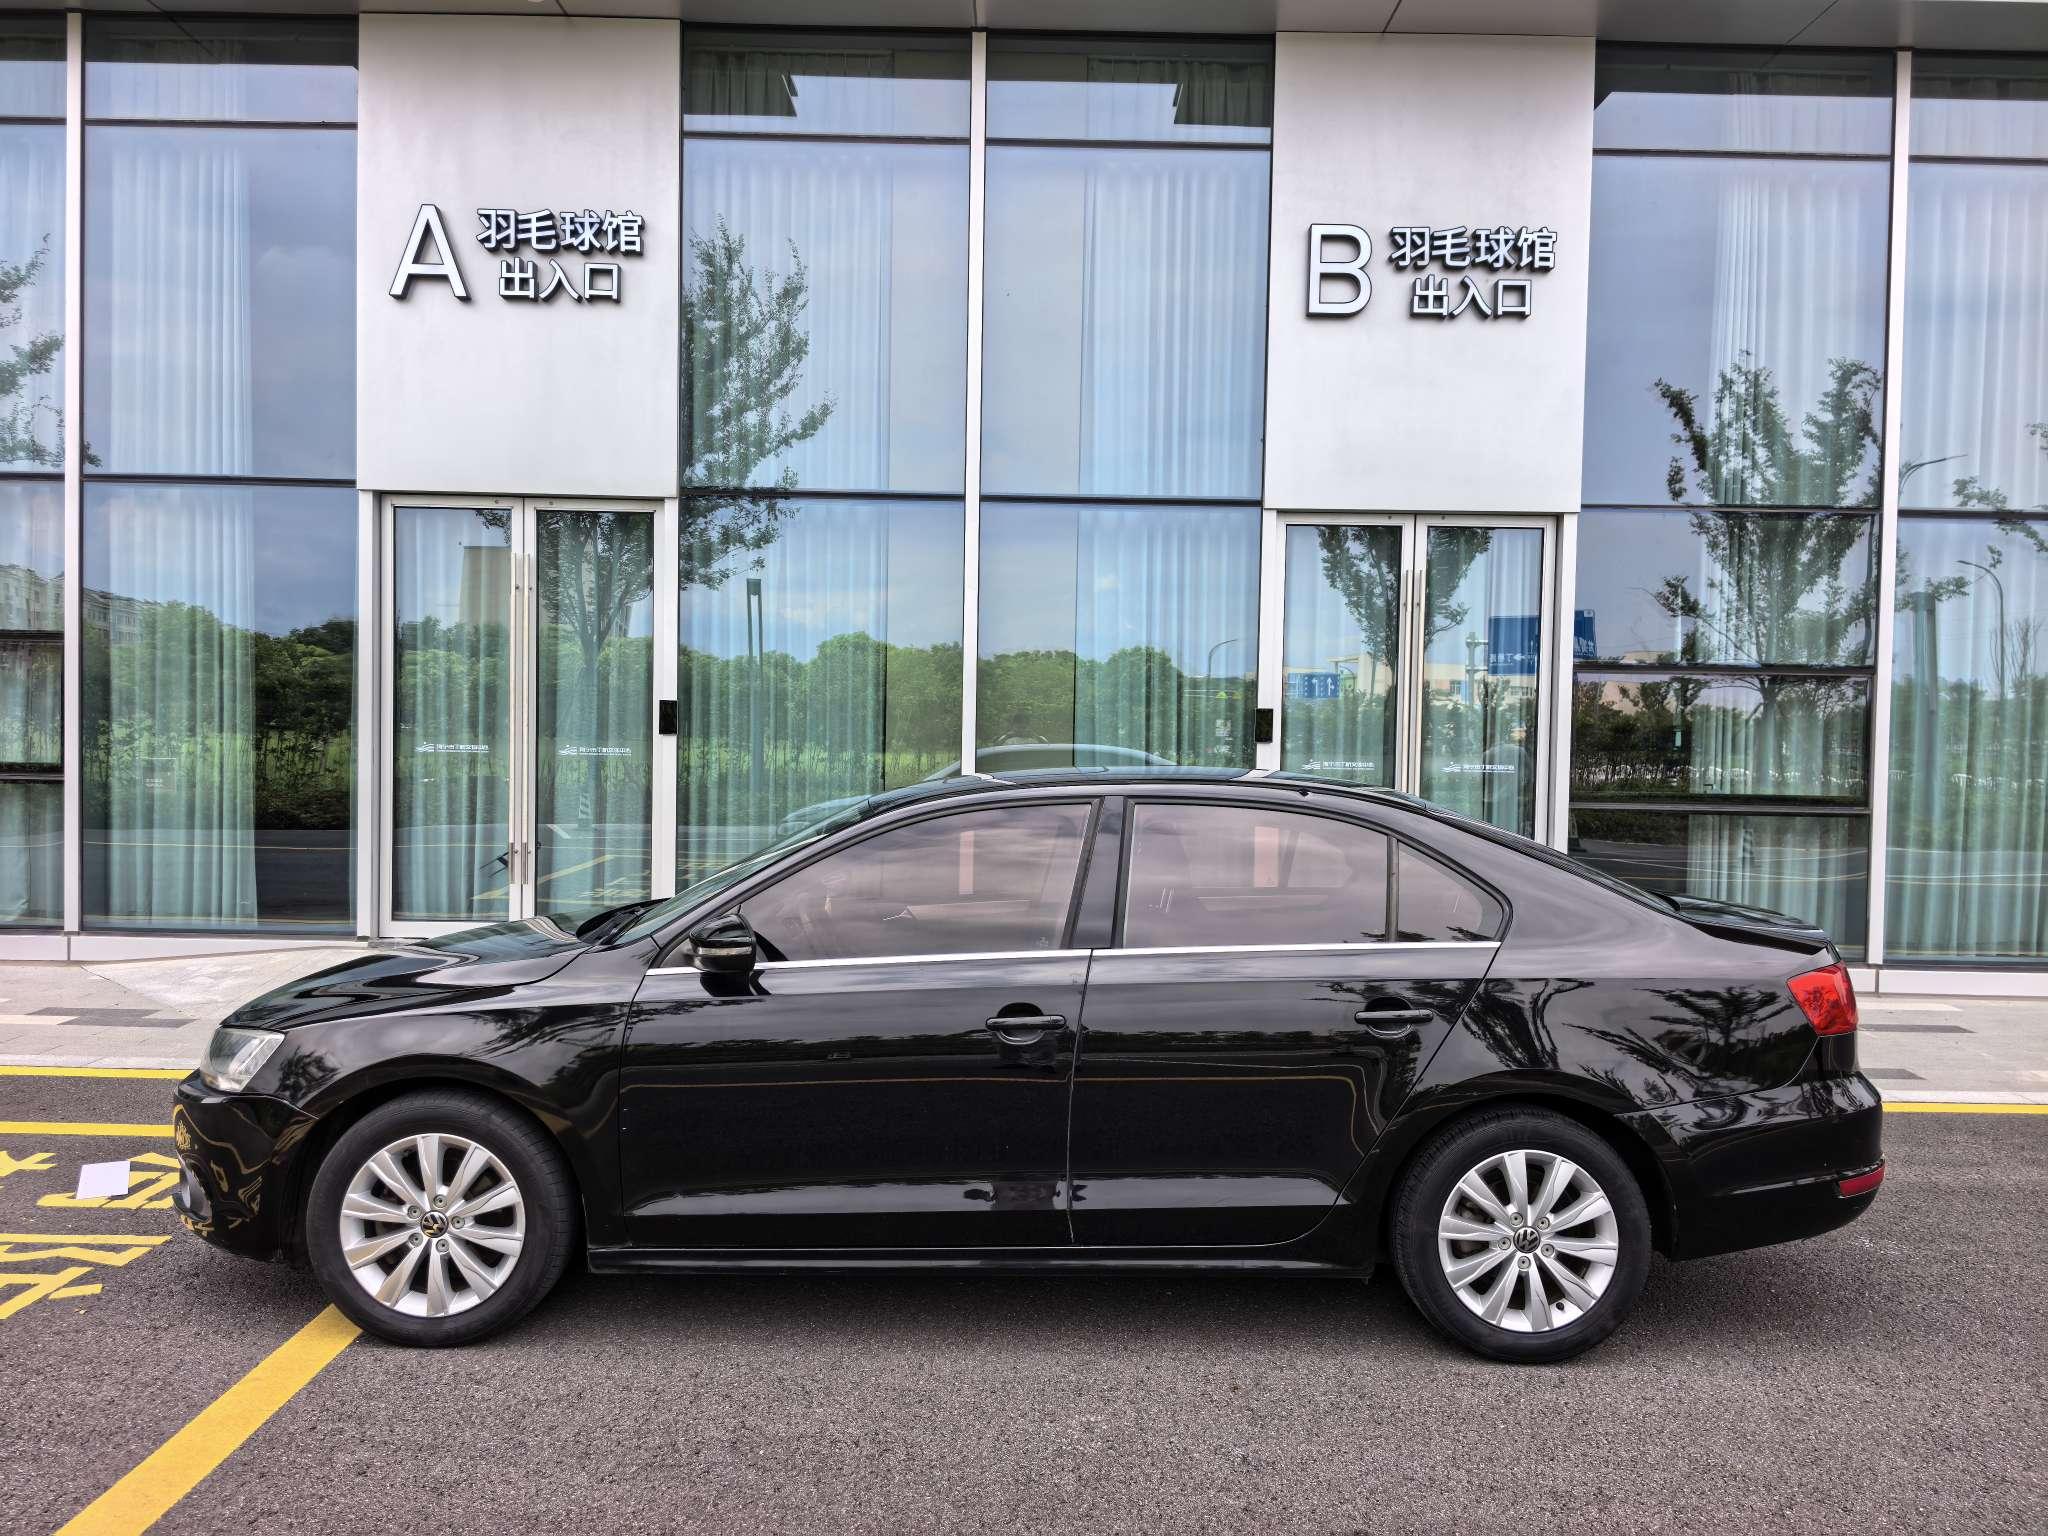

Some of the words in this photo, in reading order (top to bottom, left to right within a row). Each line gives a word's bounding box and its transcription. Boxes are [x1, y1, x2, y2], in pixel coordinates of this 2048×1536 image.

[388, 203, 471, 301] A
[475, 207, 644, 256] 羽毛球馆
[1389, 225, 1557, 271] 羽毛球馆
[498, 256, 622, 303] 出入口
[1305, 223, 1373, 317] B
[1409, 274, 1533, 319] 出入口
